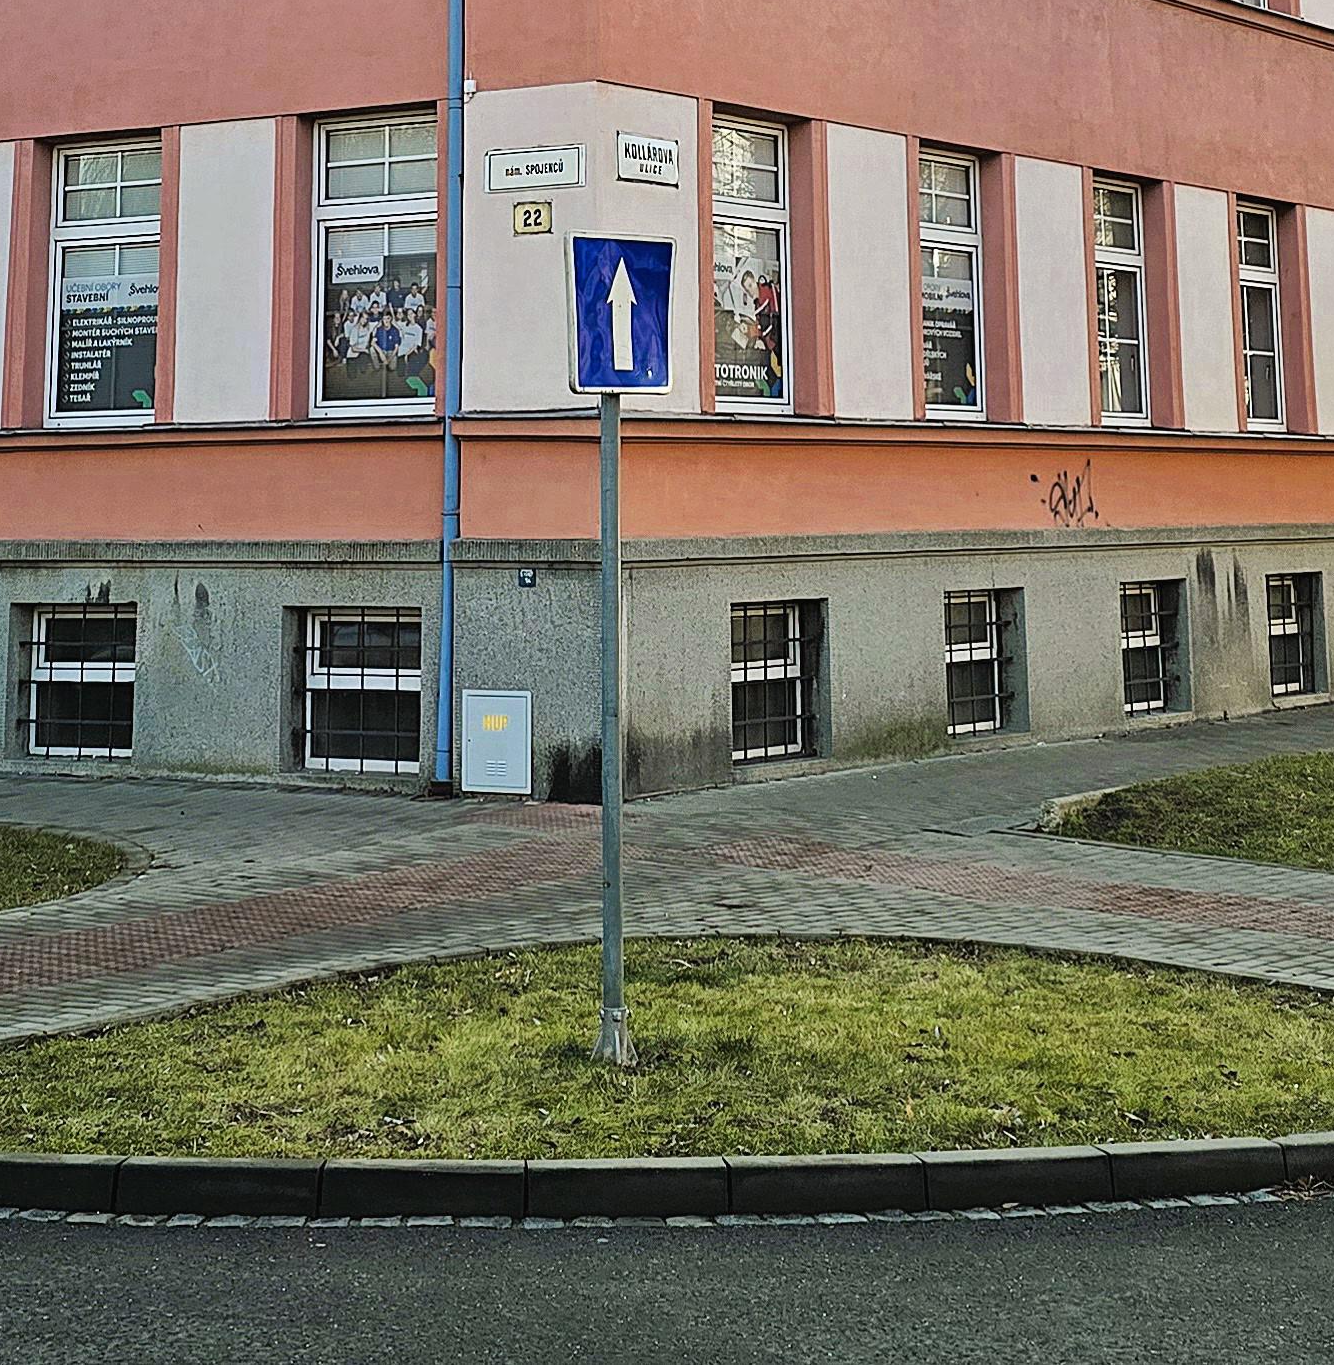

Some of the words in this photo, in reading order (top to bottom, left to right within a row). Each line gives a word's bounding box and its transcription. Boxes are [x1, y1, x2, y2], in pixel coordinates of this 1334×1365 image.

[624, 142, 674, 165] KOLLÁROVA
[525, 159, 564, 176] SPOJENCŮ
[639, 164, 662, 176] ULICE
[523, 209, 543, 228] 22
[335, 263, 381, 279] Švehlova
[66, 283, 94, 294] UČEBNÍ
[96, 281, 121, 293] OBORY
[66, 292, 108, 304] STAVEBNÍ
[714, 363, 769, 380] TOTRONIK
